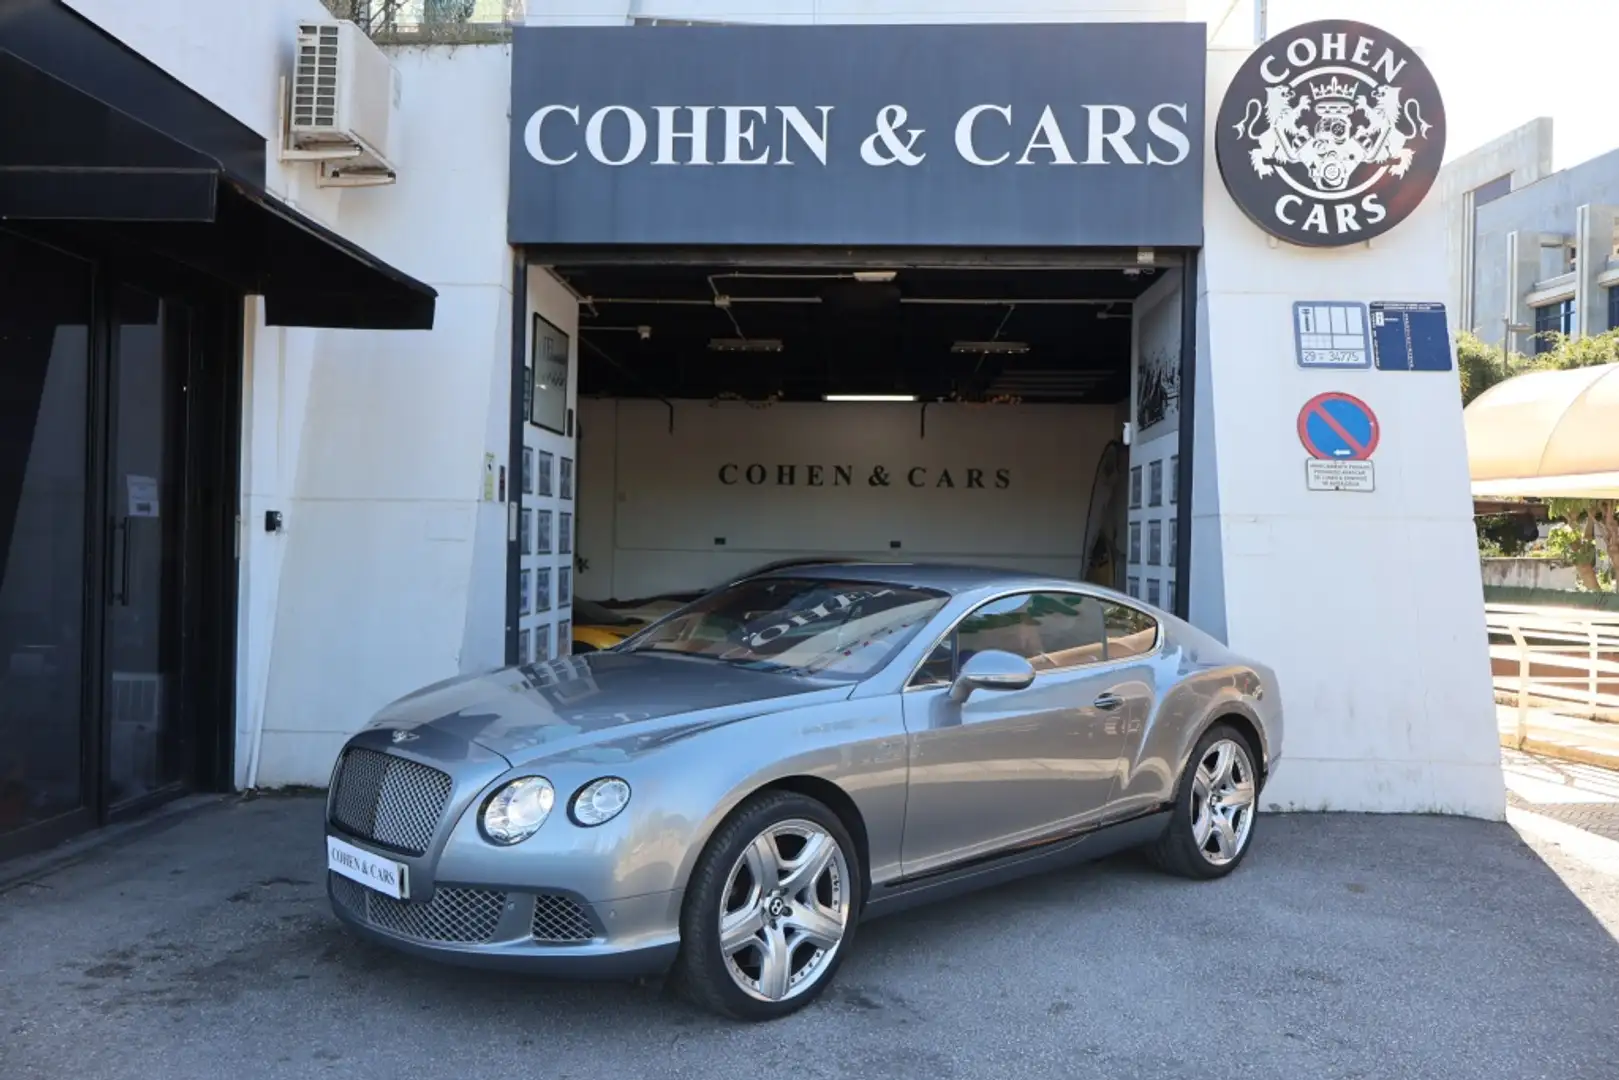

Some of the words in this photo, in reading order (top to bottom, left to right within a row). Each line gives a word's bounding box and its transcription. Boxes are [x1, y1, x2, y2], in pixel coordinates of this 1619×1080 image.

[1260, 33, 1407, 84] COHEN
[524, 104, 835, 166] COHEN
[860, 104, 926, 166] &
[954, 103, 1190, 166] CARS
[1274, 193, 1387, 234] CARS
[718, 463, 852, 486] COHEN
[868, 465, 890, 487] &
[907, 466, 1011, 489] CARS
[331, 847, 360, 872] COHEN
[361, 860, 368, 875] &
[370, 863, 396, 885] CARS
